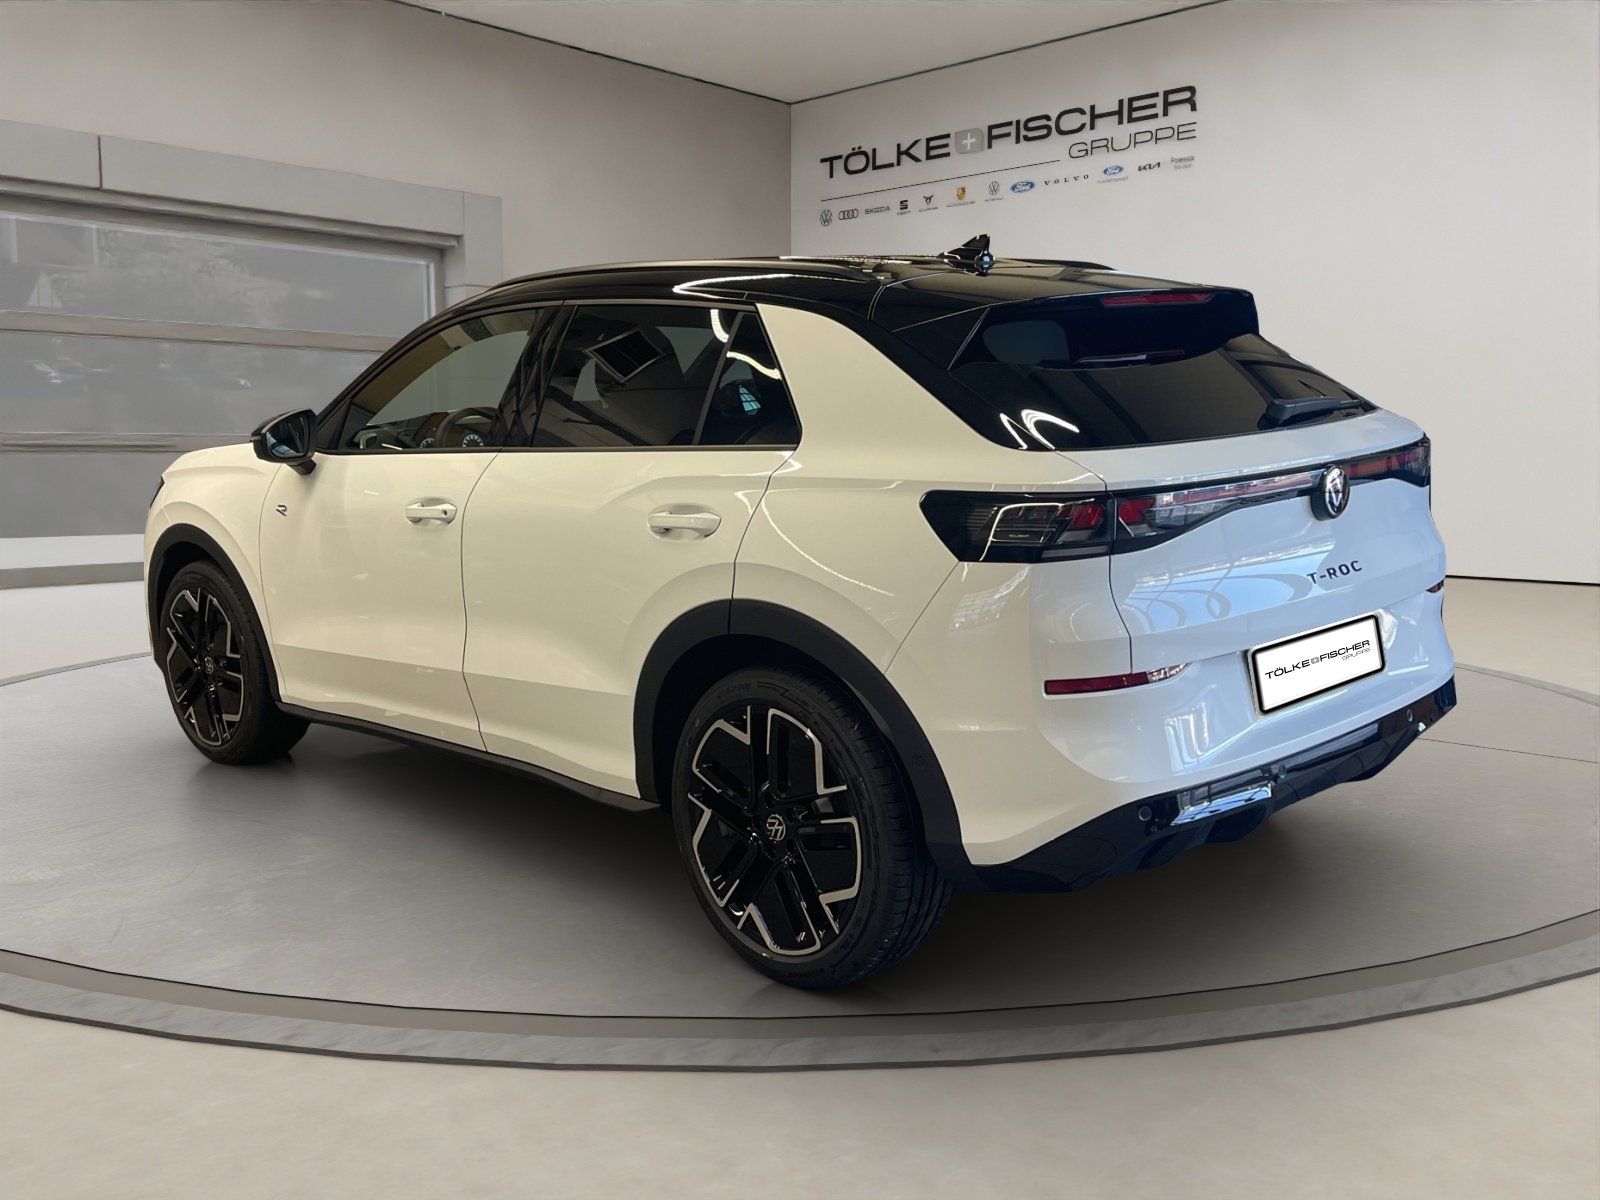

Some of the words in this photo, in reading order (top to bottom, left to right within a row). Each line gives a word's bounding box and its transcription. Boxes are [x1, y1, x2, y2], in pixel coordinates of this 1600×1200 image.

[820, 133, 951, 179] TÖLKE
[987, 85, 1197, 150] FISCHER
[1068, 121, 1198, 159] GRUPPE
[1043, 174, 1089, 186] VOLVO
[1307, 560, 1362, 584] T-ROC
[1264, 658, 1311, 680] TÖLKE
[1319, 639, 1371, 663] FISCHER
